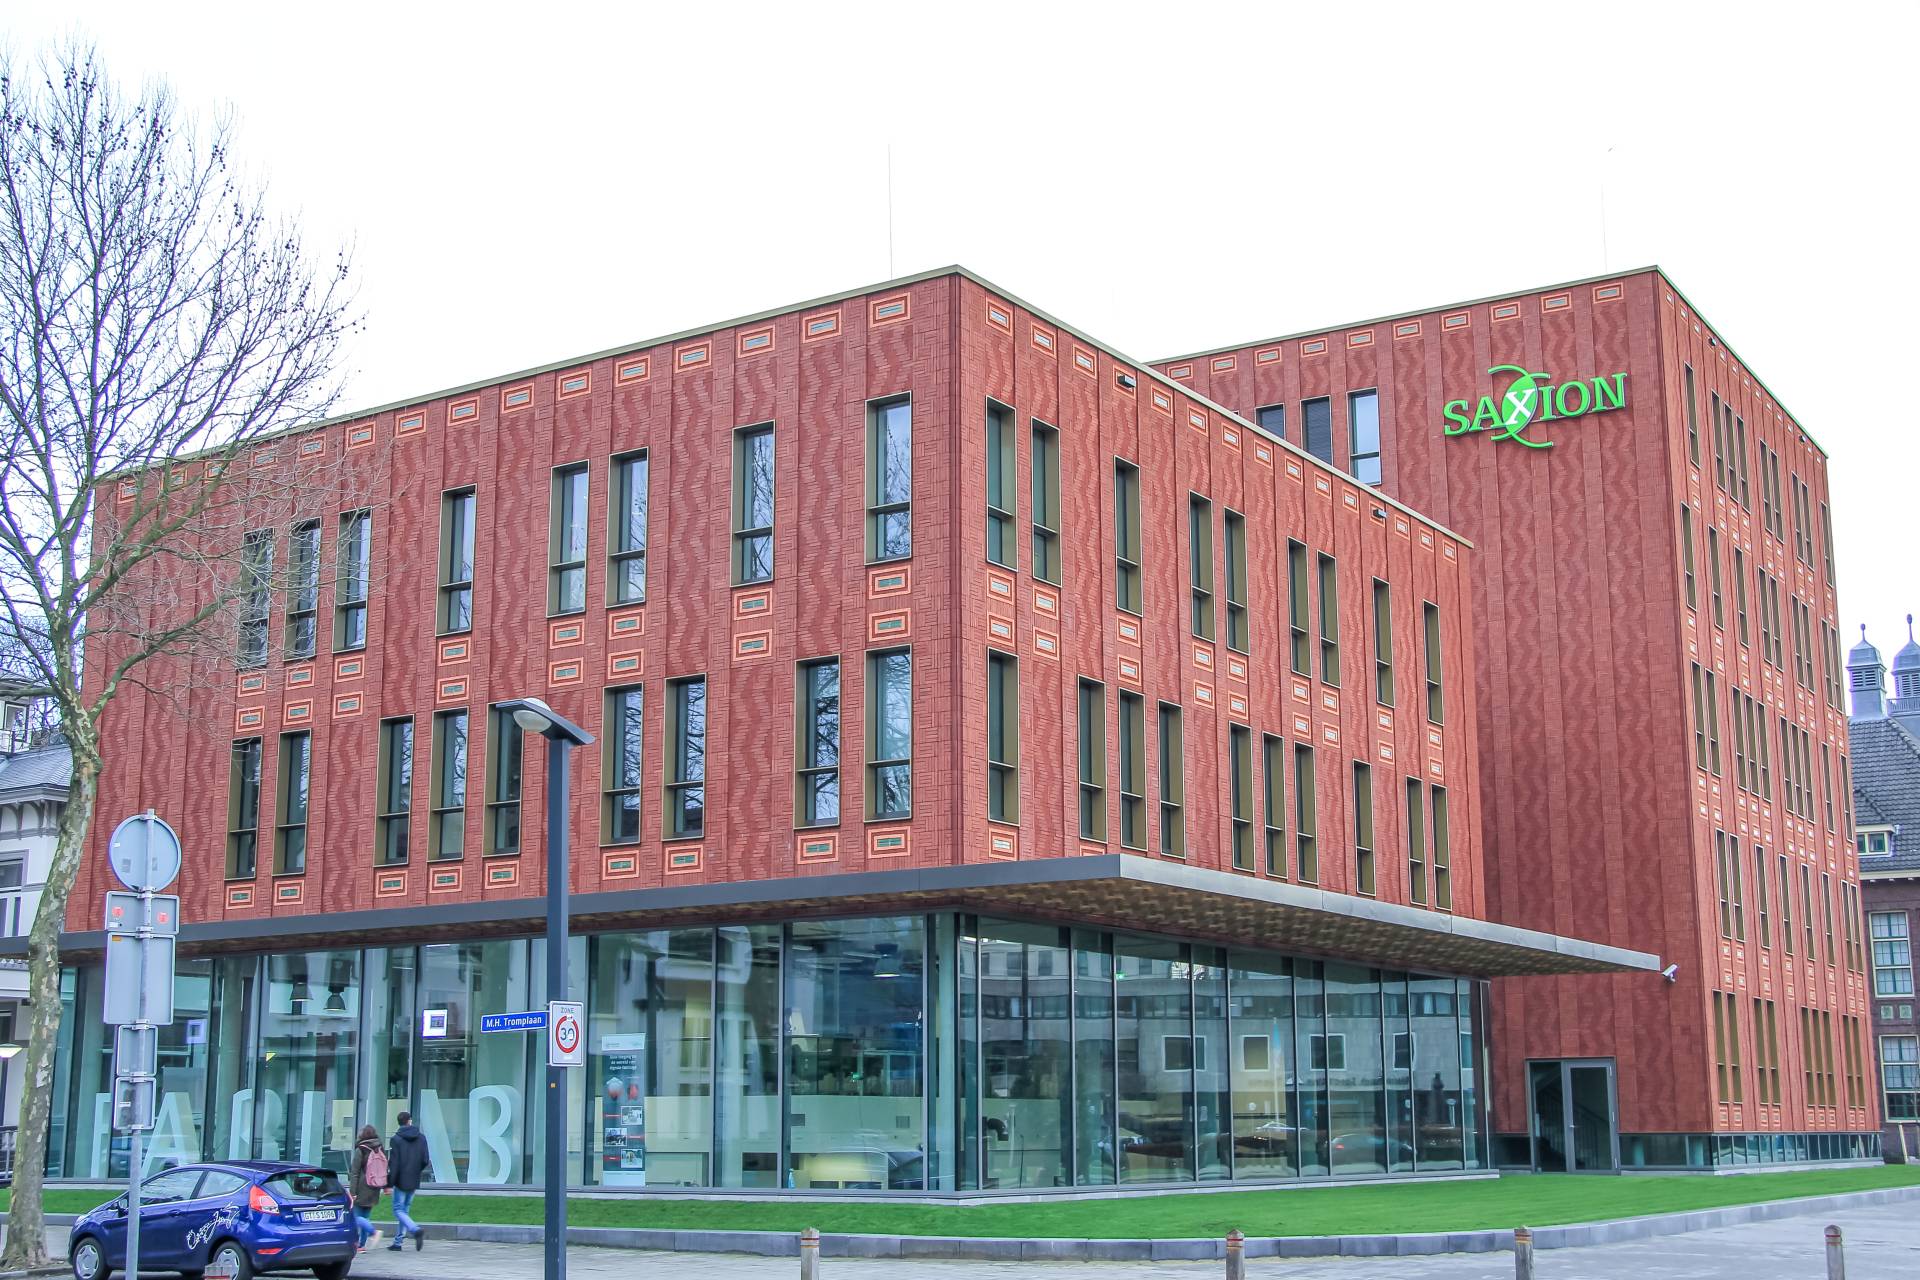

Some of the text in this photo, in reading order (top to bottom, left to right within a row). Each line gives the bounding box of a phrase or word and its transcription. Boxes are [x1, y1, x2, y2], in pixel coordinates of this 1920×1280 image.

[1443, 372, 1628, 436] SAXION
[486, 1016, 542, 1028] M.H. Tromplaan
[560, 1027, 575, 1041] 30
